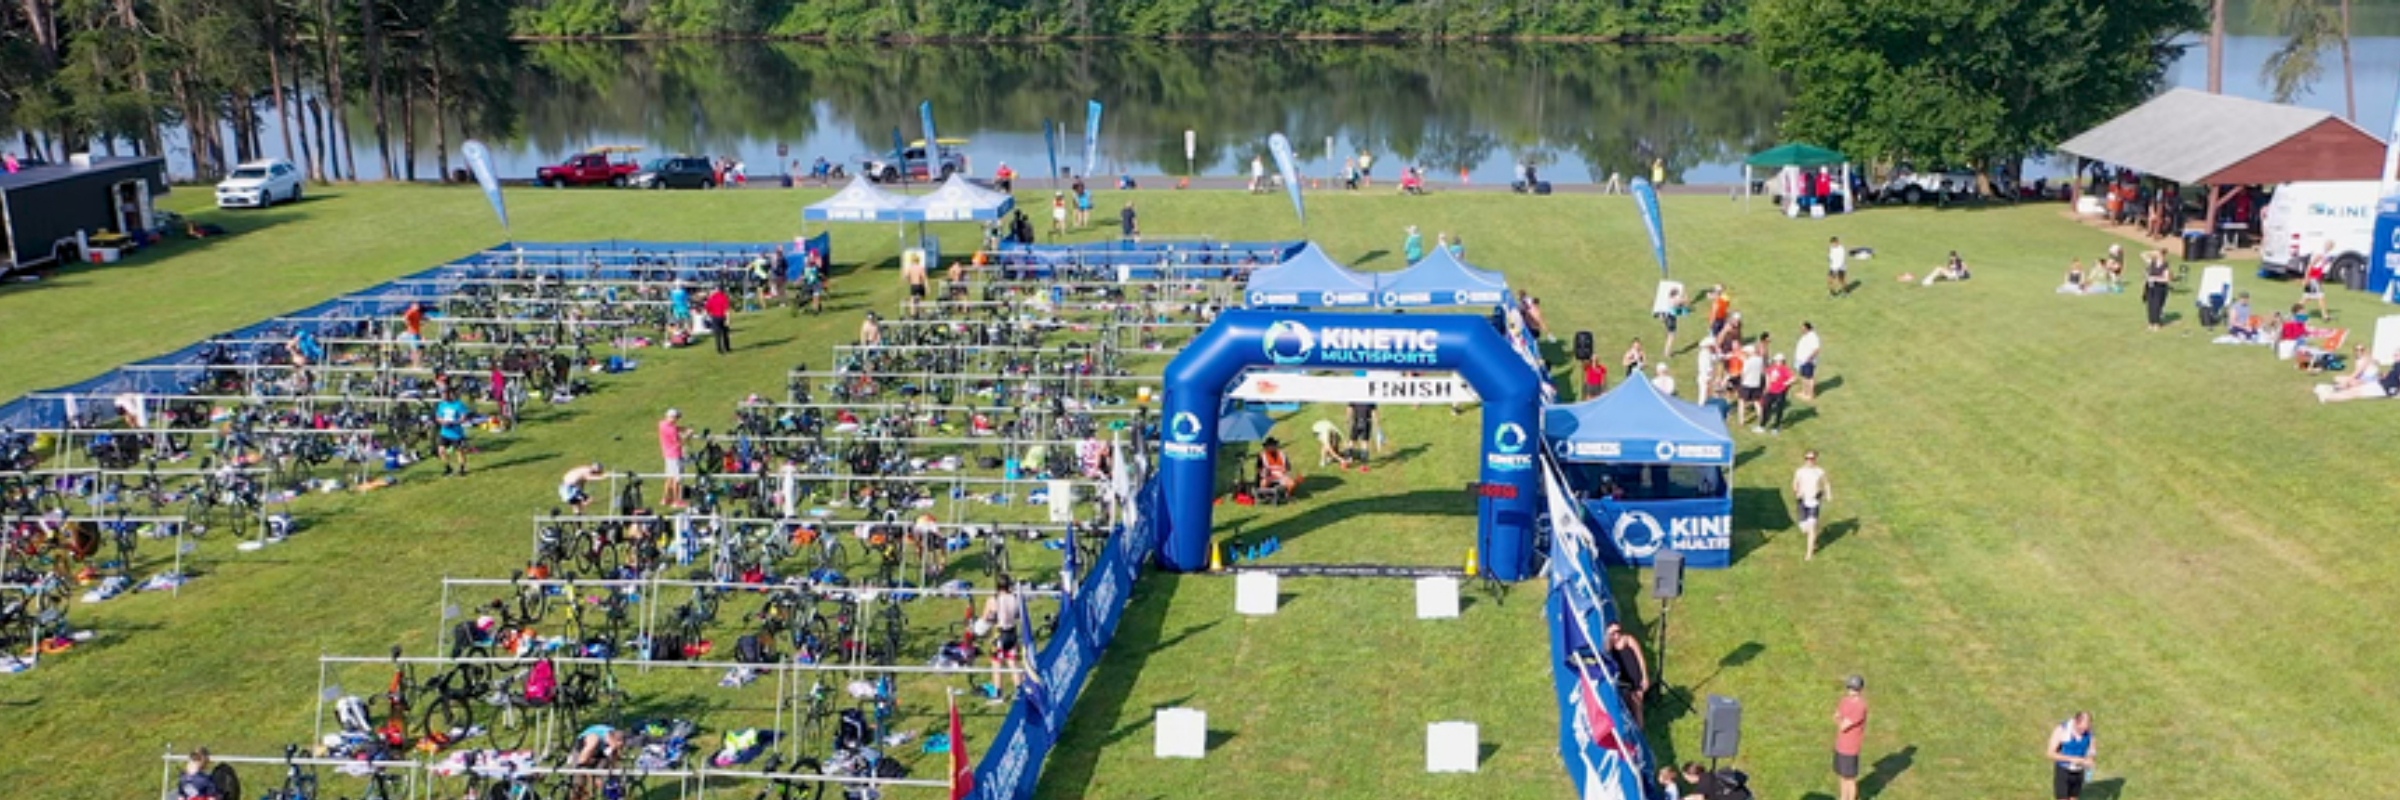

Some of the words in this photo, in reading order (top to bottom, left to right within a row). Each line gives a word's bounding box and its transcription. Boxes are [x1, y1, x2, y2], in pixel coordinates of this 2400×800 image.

[1321, 327, 1439, 351] KINETIC
[1321, 350, 1438, 364] MULTISPORTS
[1368, 381, 1451, 398] FINISH
